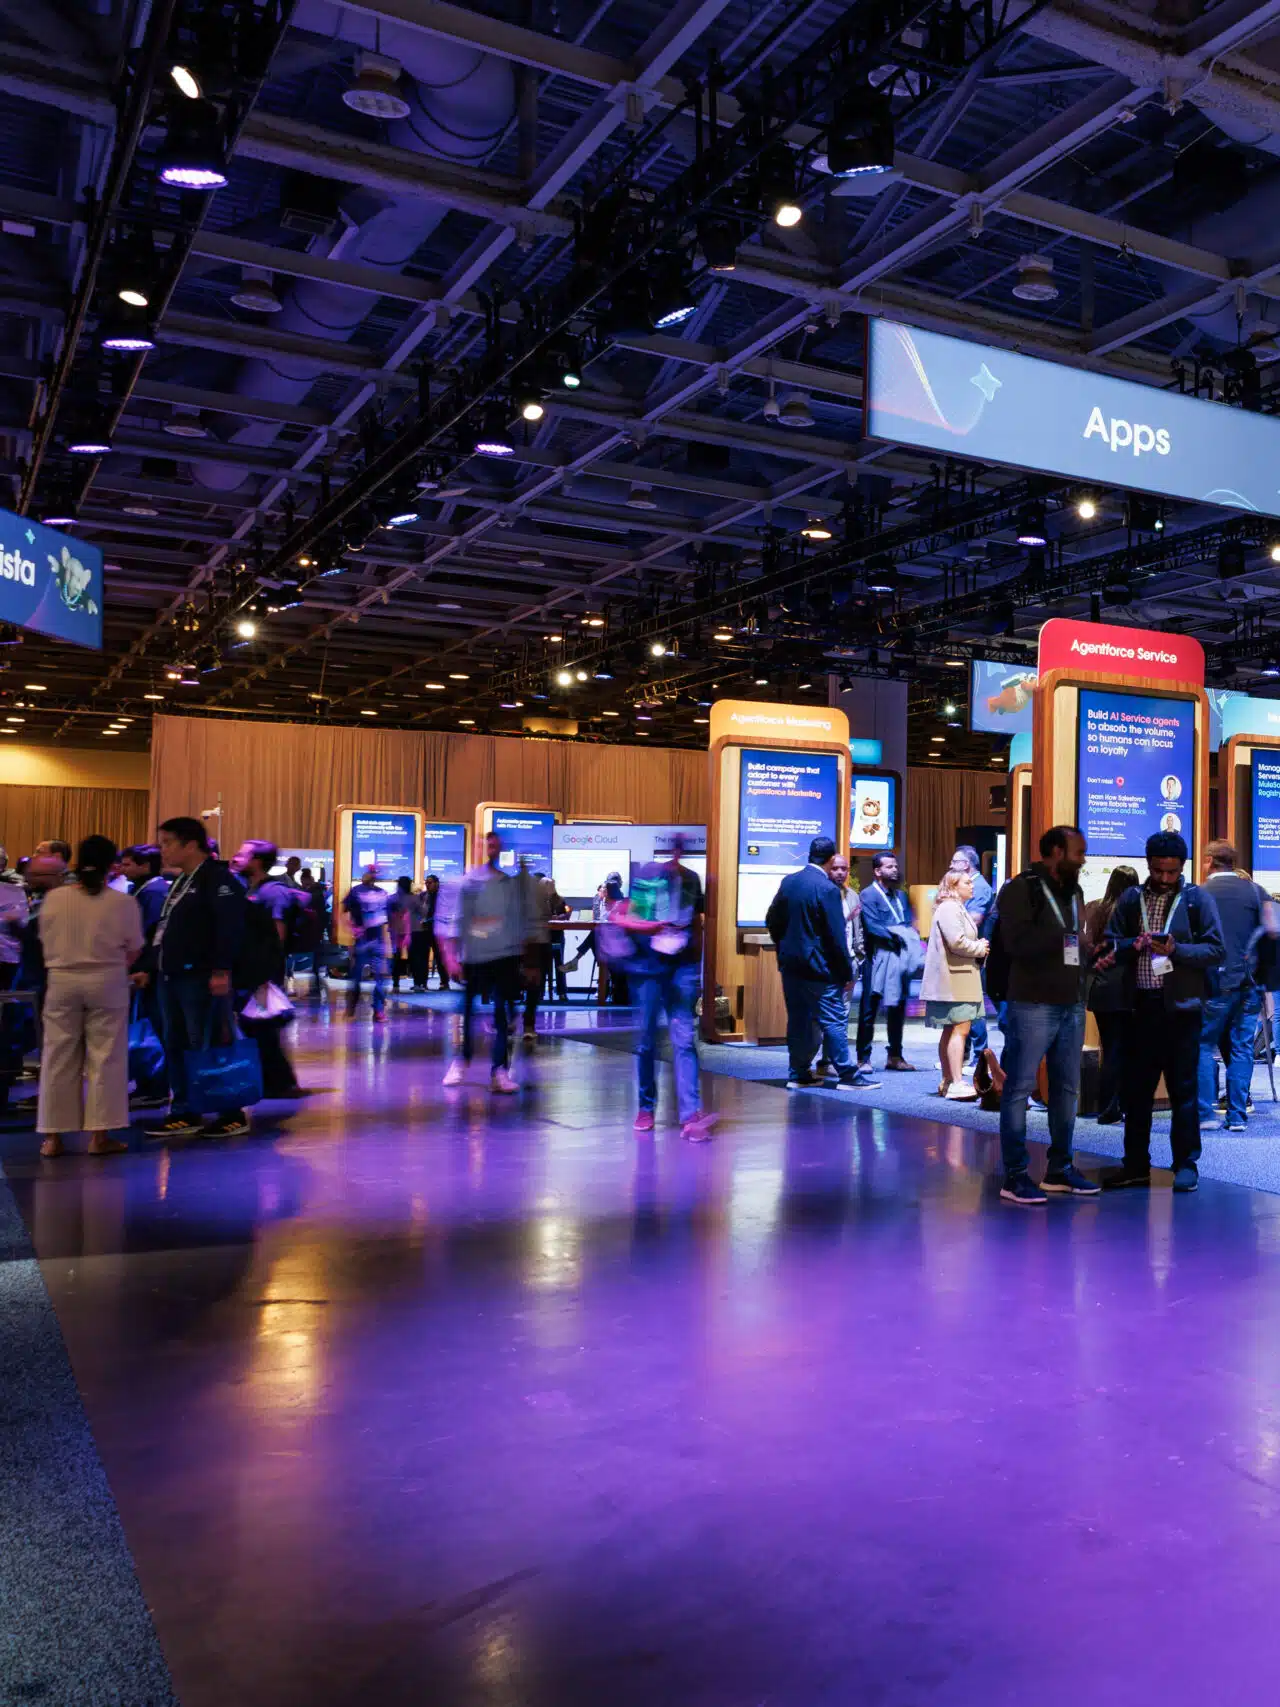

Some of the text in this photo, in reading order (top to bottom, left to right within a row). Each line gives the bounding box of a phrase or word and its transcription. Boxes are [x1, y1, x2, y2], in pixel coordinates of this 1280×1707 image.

[1083, 406, 1171, 456] Apps
[1070, 639, 1178, 664] Agentforce Service
[1088, 709, 1180, 727] Build AI Service agents
[1088, 721, 1176, 739] to absorb the volume,
[1088, 734, 1174, 748] so humans can focus
[1087, 745, 1128, 757] on loyalty
[748, 763, 820, 775] Build campaigns that
[747, 771, 770, 779] adapt
[779, 774, 799, 782] every
[747, 779, 795, 788] customer with
[747, 788, 822, 799] Agentforce Marketing
[563, 835, 618, 845] Google Cloud
